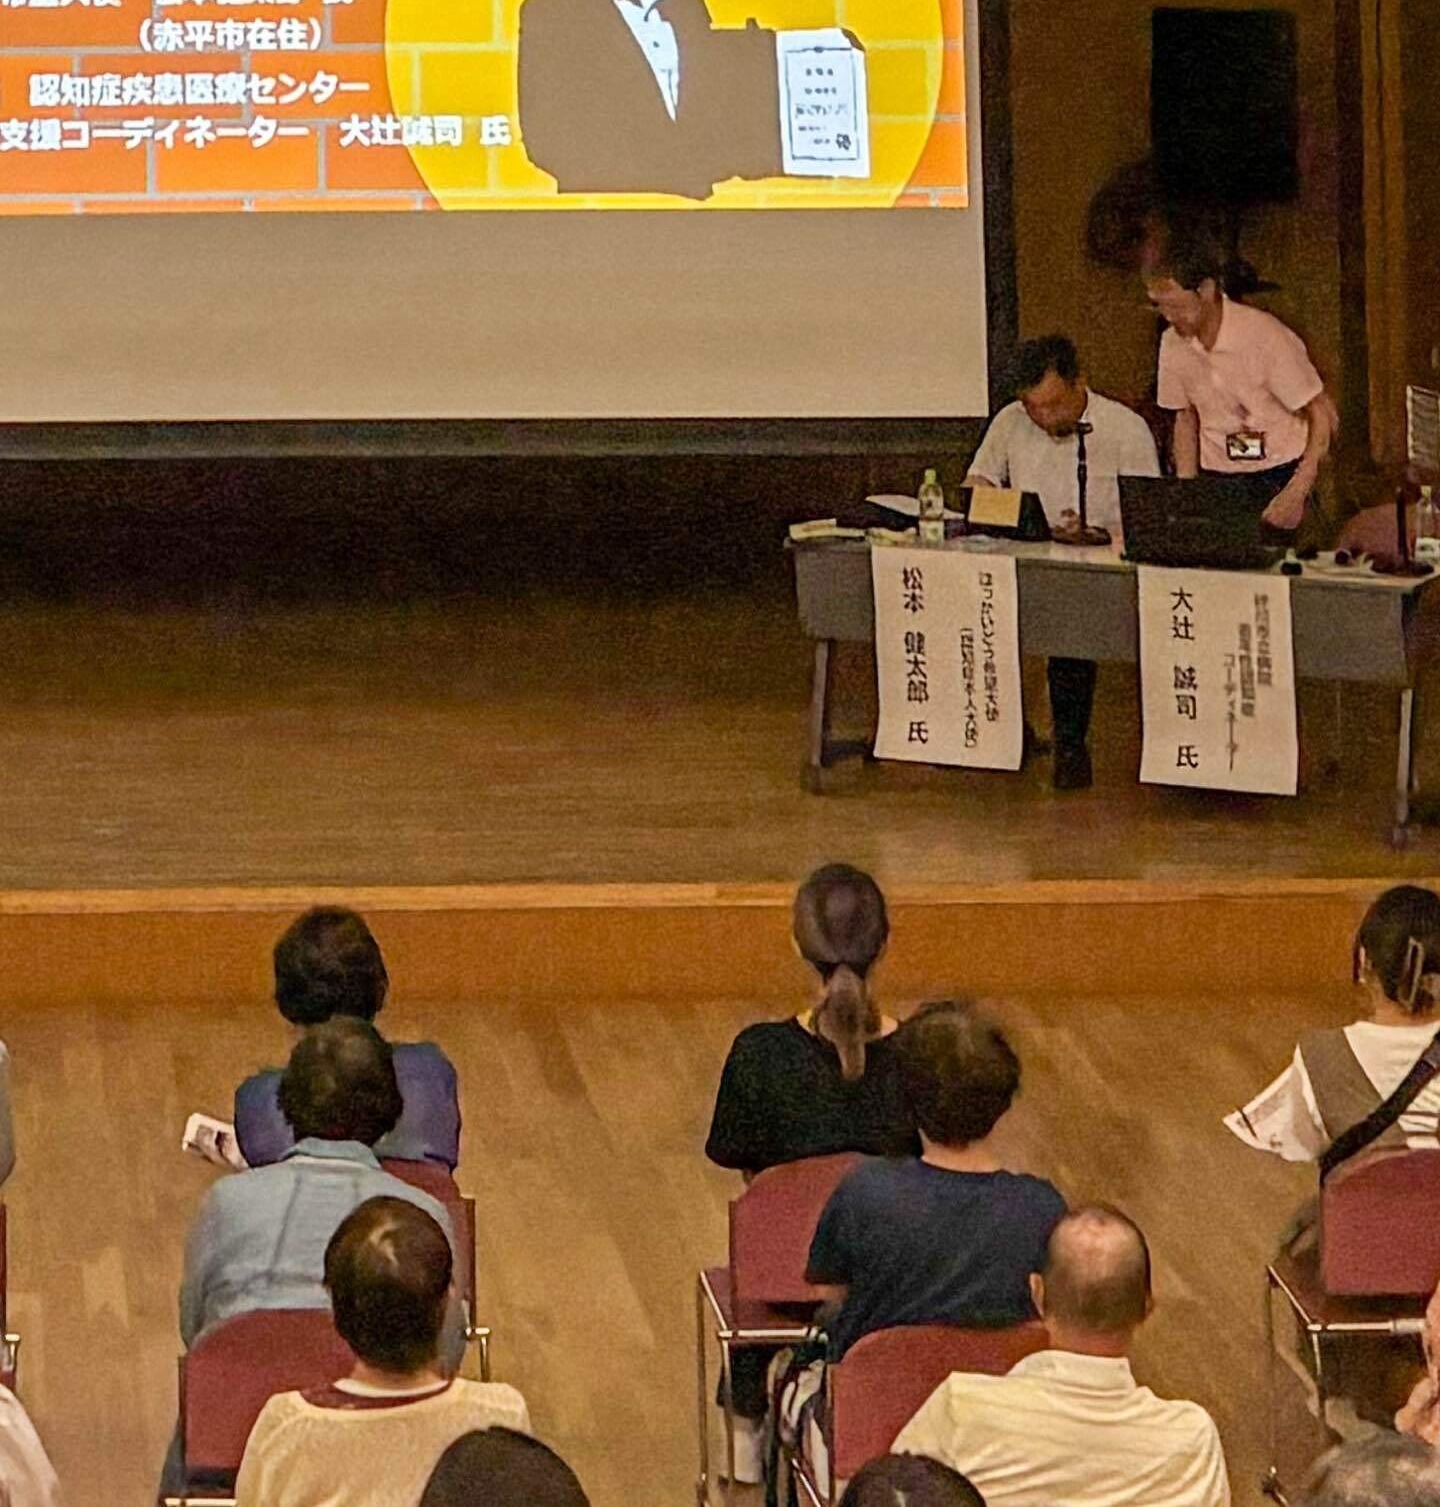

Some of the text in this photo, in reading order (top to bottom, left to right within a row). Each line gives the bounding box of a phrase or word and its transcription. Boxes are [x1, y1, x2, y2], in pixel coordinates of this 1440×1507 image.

[28, 71, 371, 107] 認知症疾患医療センター
[480, 115, 511, 146] 氏
[908, 720, 930, 745] 氏
[1175, 743, 1200, 770] 氏
